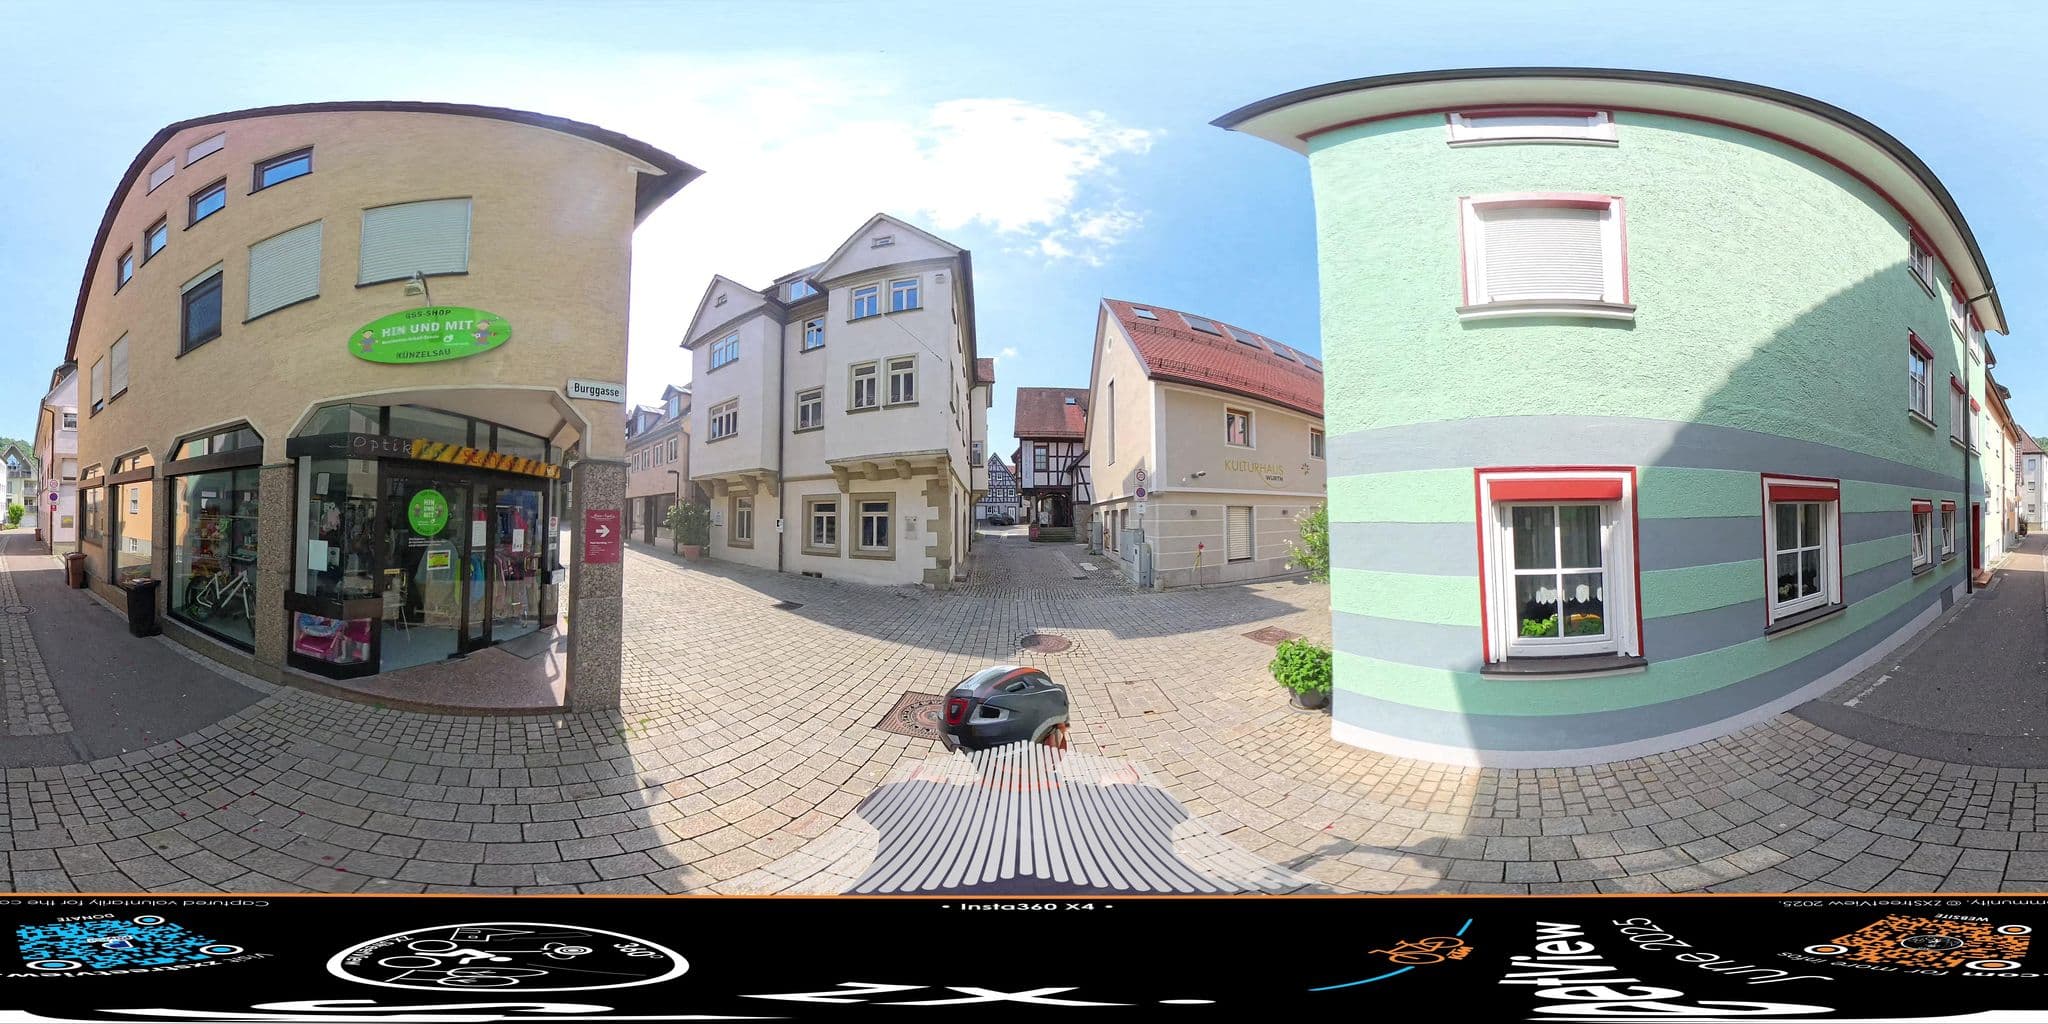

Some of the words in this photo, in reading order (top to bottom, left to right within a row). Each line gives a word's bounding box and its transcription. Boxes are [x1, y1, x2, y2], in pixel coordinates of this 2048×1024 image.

[382, 325, 406, 338] HIN
[410, 322, 440, 334] UND
[445, 319, 473, 331] MIT
[574, 382, 620, 397] Burggasse
[1224, 459, 1284, 475] KULTURHAUS
